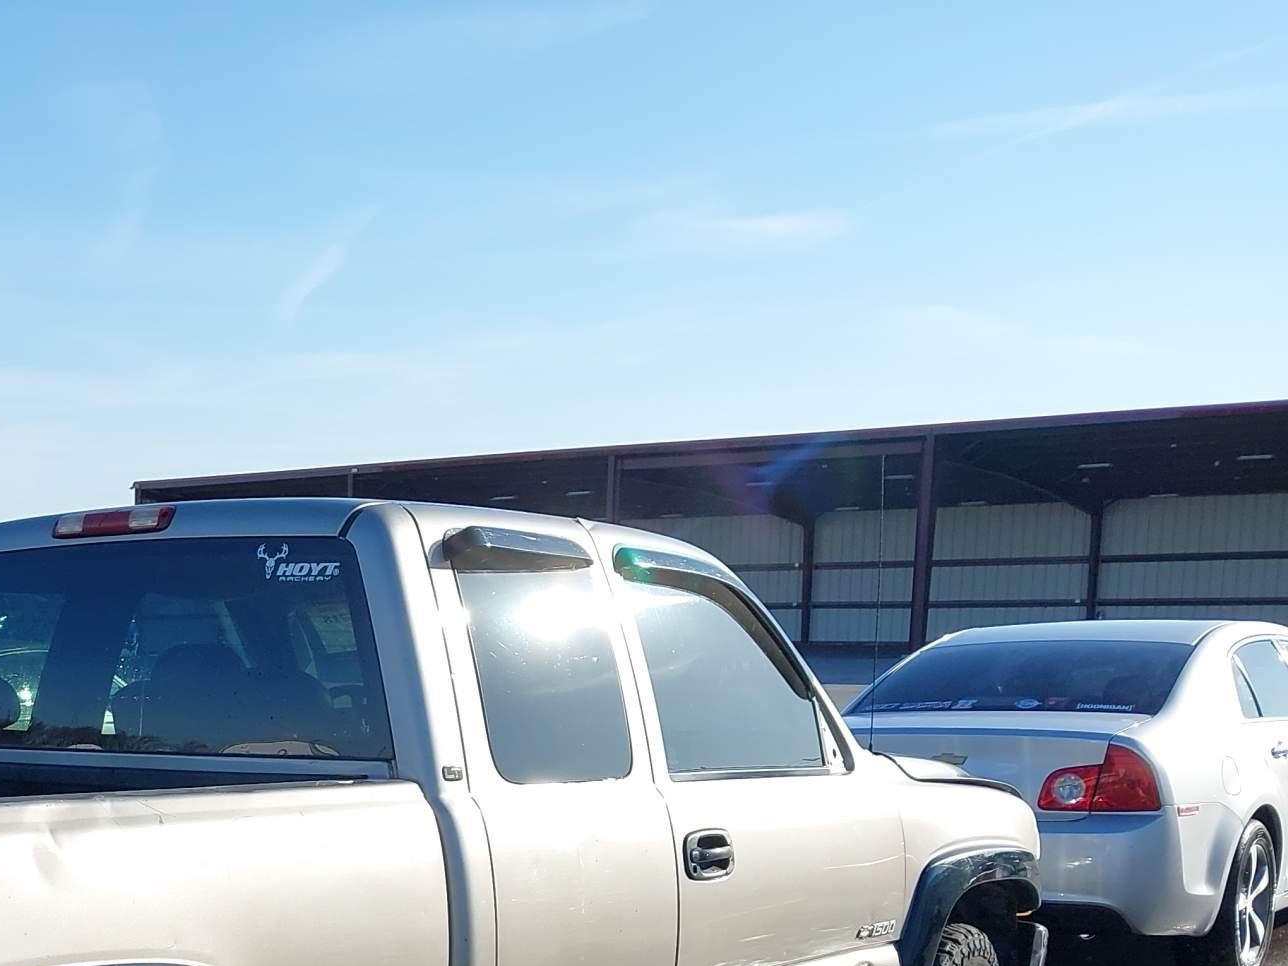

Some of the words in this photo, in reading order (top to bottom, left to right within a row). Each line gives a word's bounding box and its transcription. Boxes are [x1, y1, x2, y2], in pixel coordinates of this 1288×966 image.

[276, 561, 341, 577] HOYT
[278, 575, 332, 583] ARCHERY
[872, 919, 897, 937] 1500
